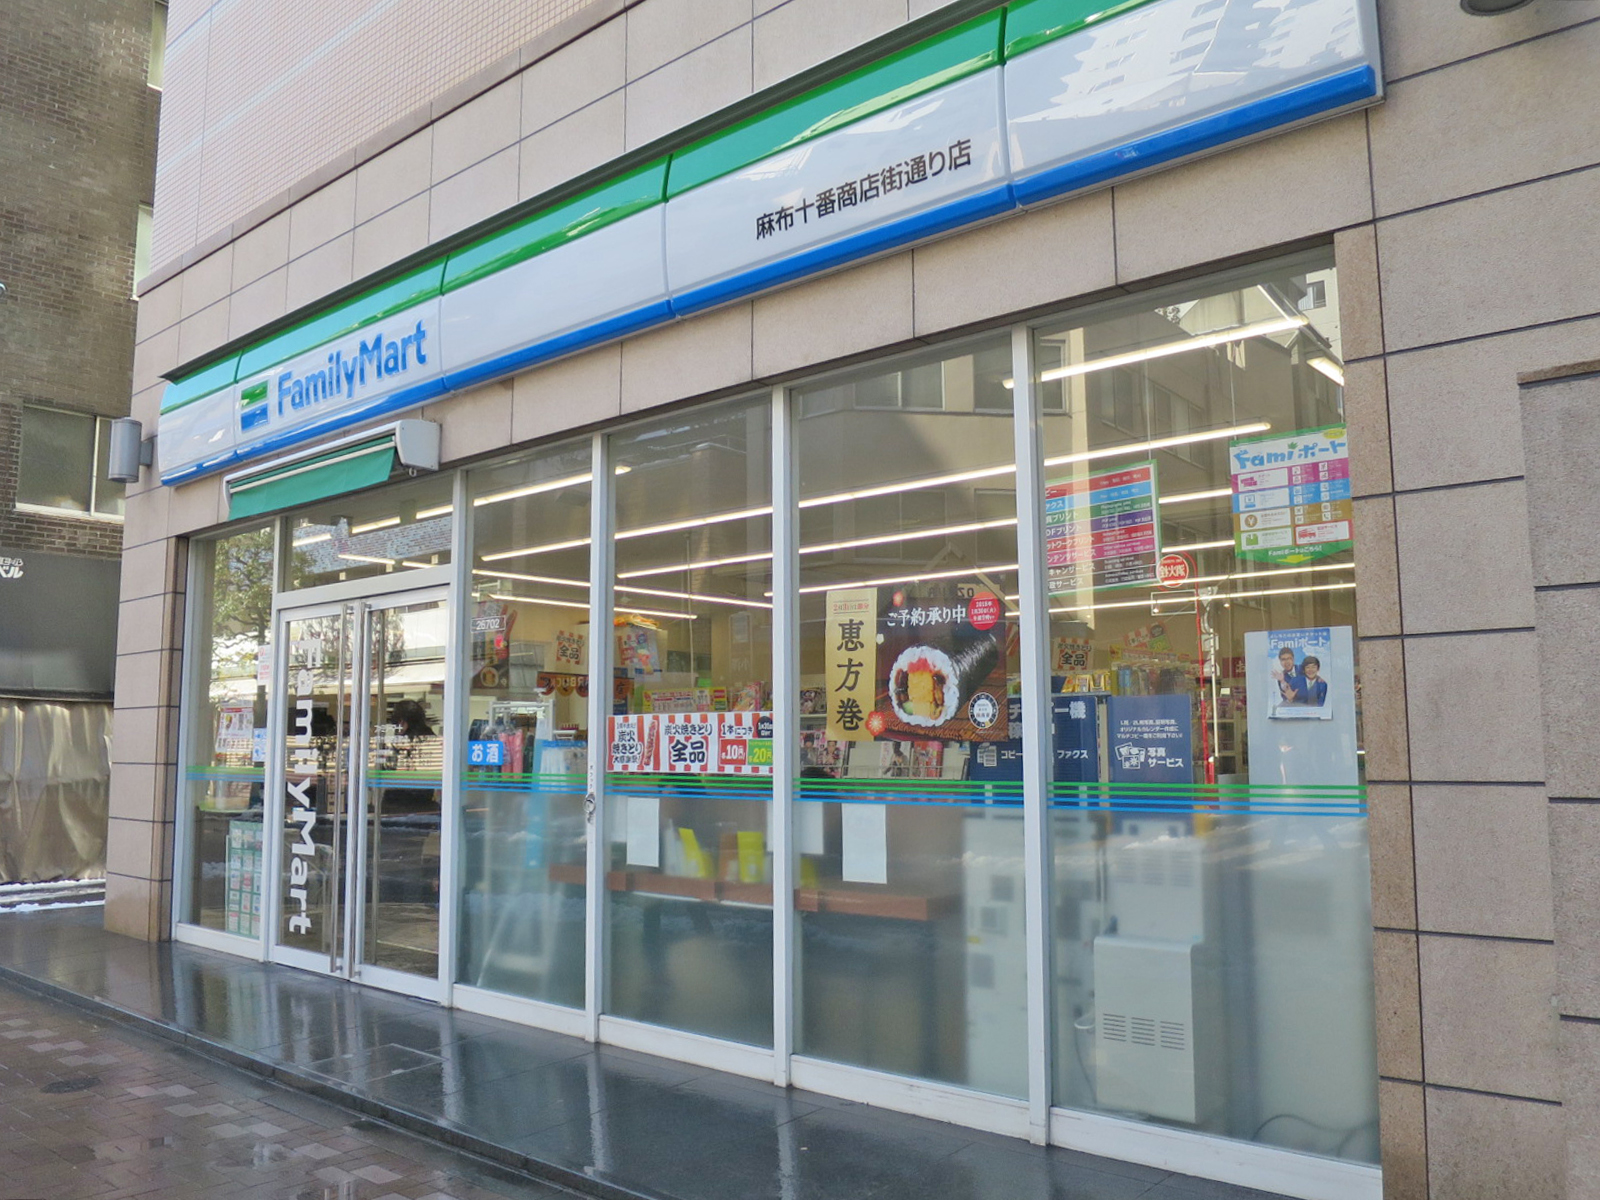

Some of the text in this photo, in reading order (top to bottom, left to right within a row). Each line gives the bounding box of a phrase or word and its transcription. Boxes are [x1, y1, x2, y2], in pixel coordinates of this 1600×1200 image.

[756, 138, 972, 241] 麻布十番商店街通り店
[278, 319, 427, 417] FamilyMart
[886, 604, 967, 627] ご予約承り中
[1061, 651, 1086, 667] 全品
[835, 618, 866, 731] 恵方巻
[618, 730, 636, 742] 炭火
[664, 723, 713, 737] 炭火焼きとり
[471, 743, 499, 763] お酒
[671, 739, 706, 764] 全品
[1057, 749, 1089, 759] ファクス
[1147, 747, 1166, 757] 写真
[1148, 757, 1184, 768] サービス
[287, 638, 323, 936] FamilyMart
